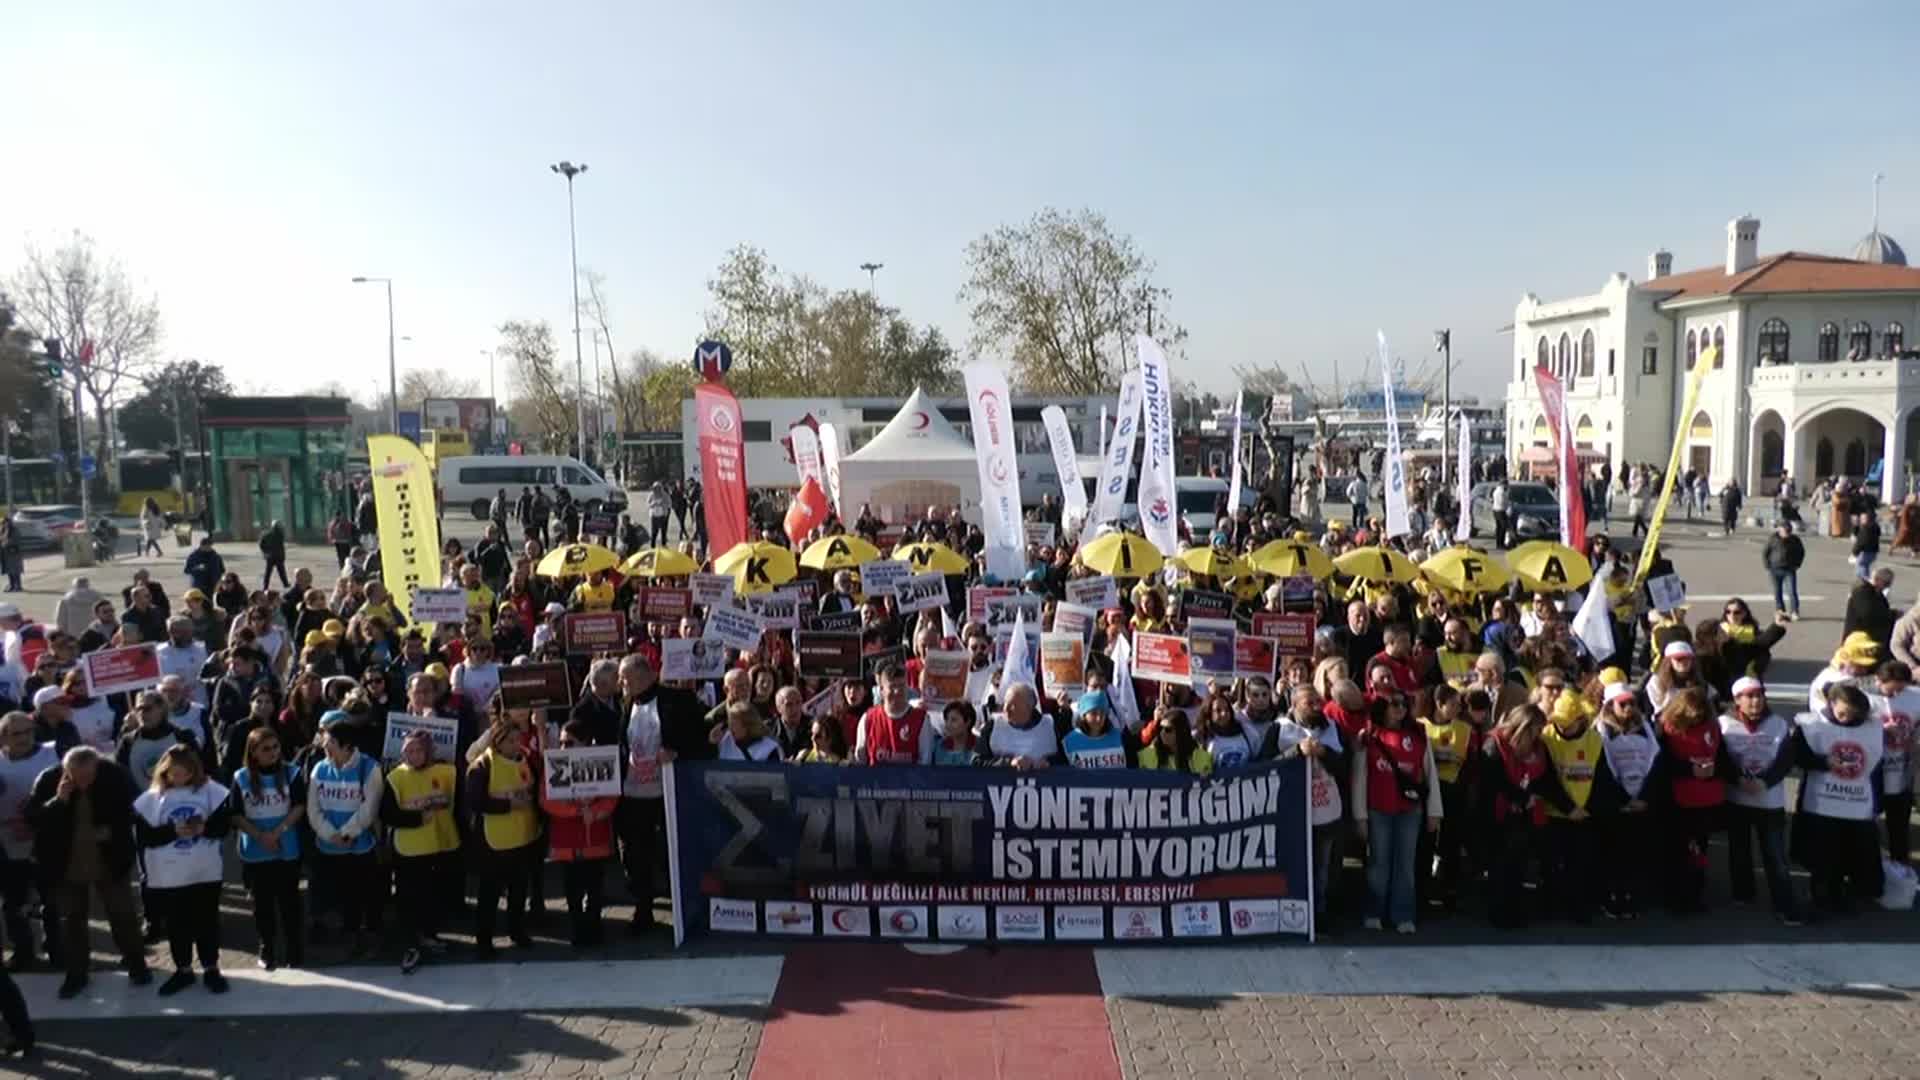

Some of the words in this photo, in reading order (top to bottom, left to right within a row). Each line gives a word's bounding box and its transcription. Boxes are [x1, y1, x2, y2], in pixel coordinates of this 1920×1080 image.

[699, 346, 722, 372] M
[827, 538, 851, 557] A
[1288, 545, 1308, 566] T
[747, 556, 771, 583] K
[1462, 558, 1483, 582] F
[1541, 556, 1567, 583] A
[987, 769, 1281, 830] YÖNETMELİĞİNİ
[991, 824, 1278, 880] İSTEMİYORUZ!
